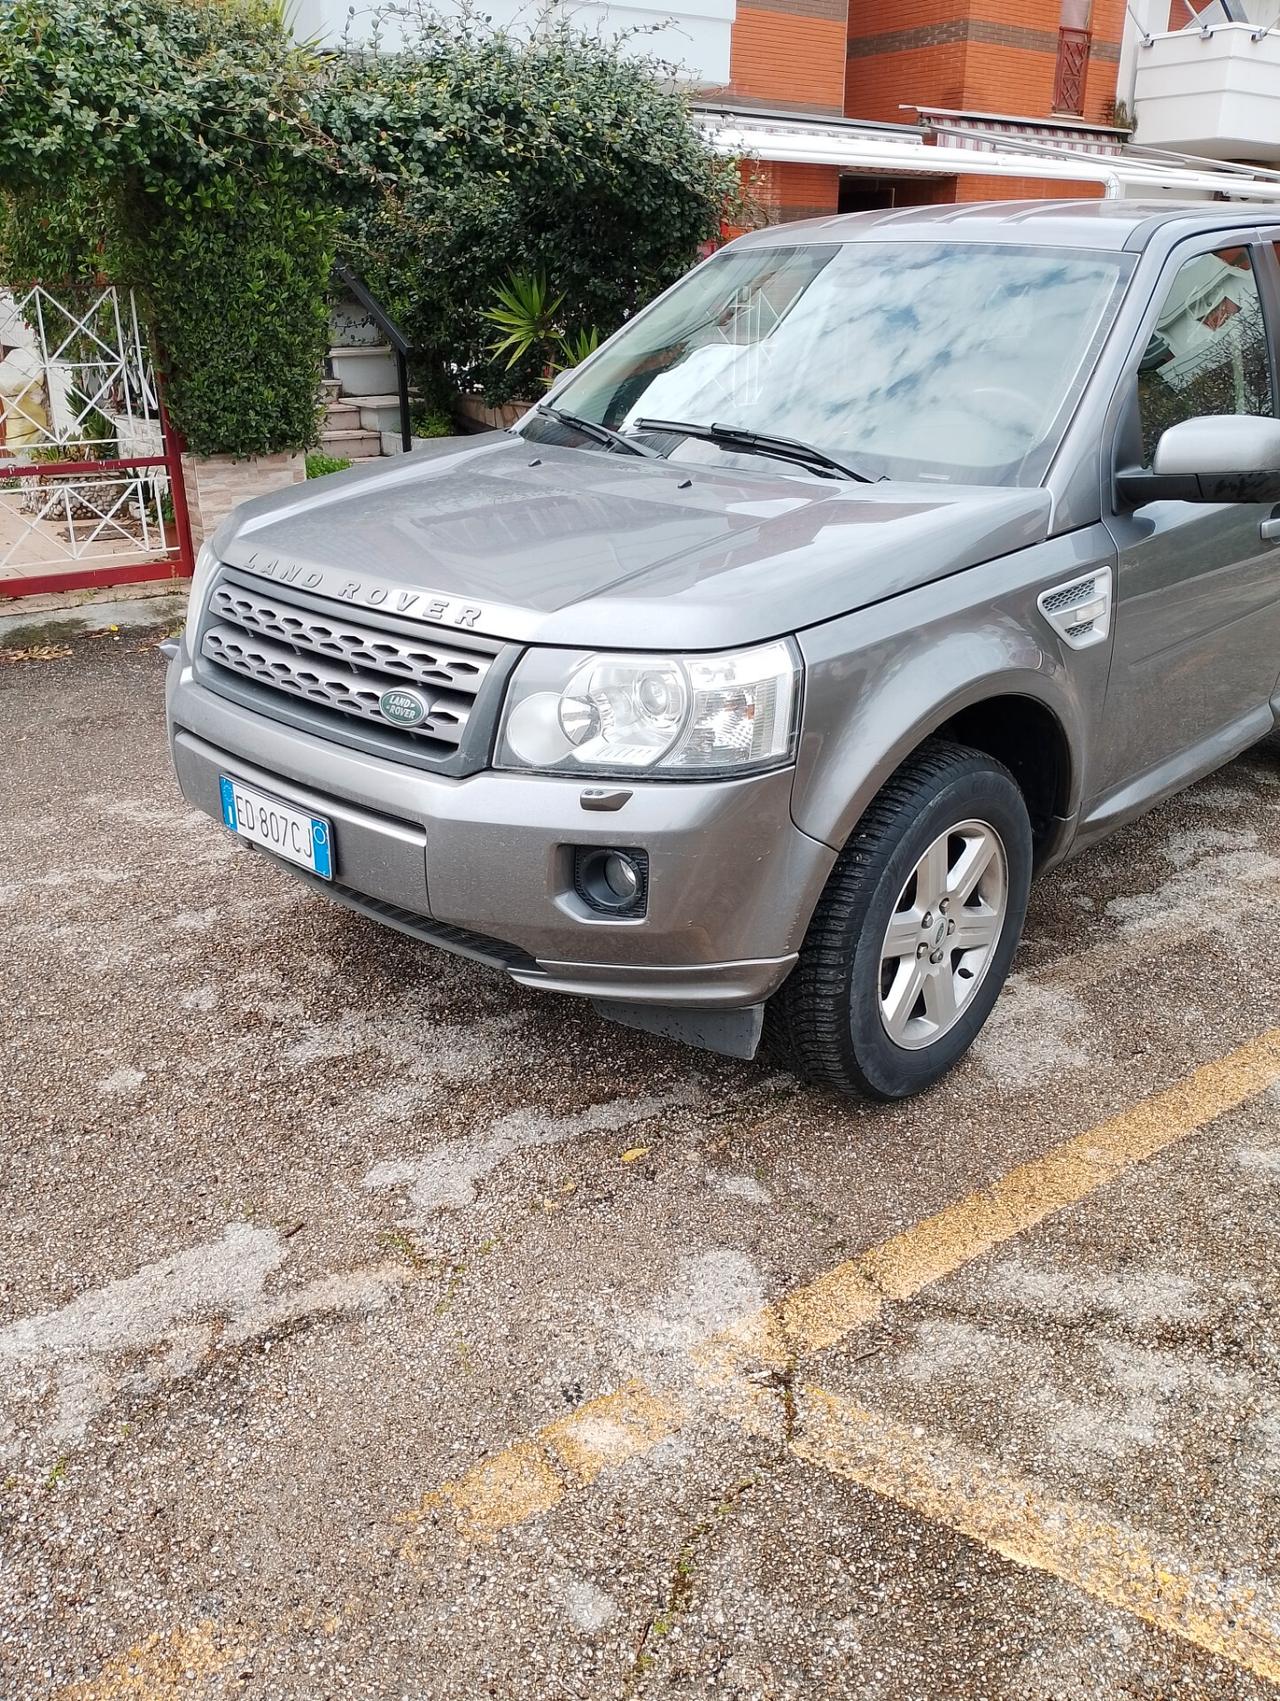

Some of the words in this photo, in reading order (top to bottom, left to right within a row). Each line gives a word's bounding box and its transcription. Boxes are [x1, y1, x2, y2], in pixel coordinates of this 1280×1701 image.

[243, 552, 324, 589] LAND
[338, 582, 482, 628] ROVER
[389, 695, 411, 708] LAND
[389, 704, 416, 719] ROVER
